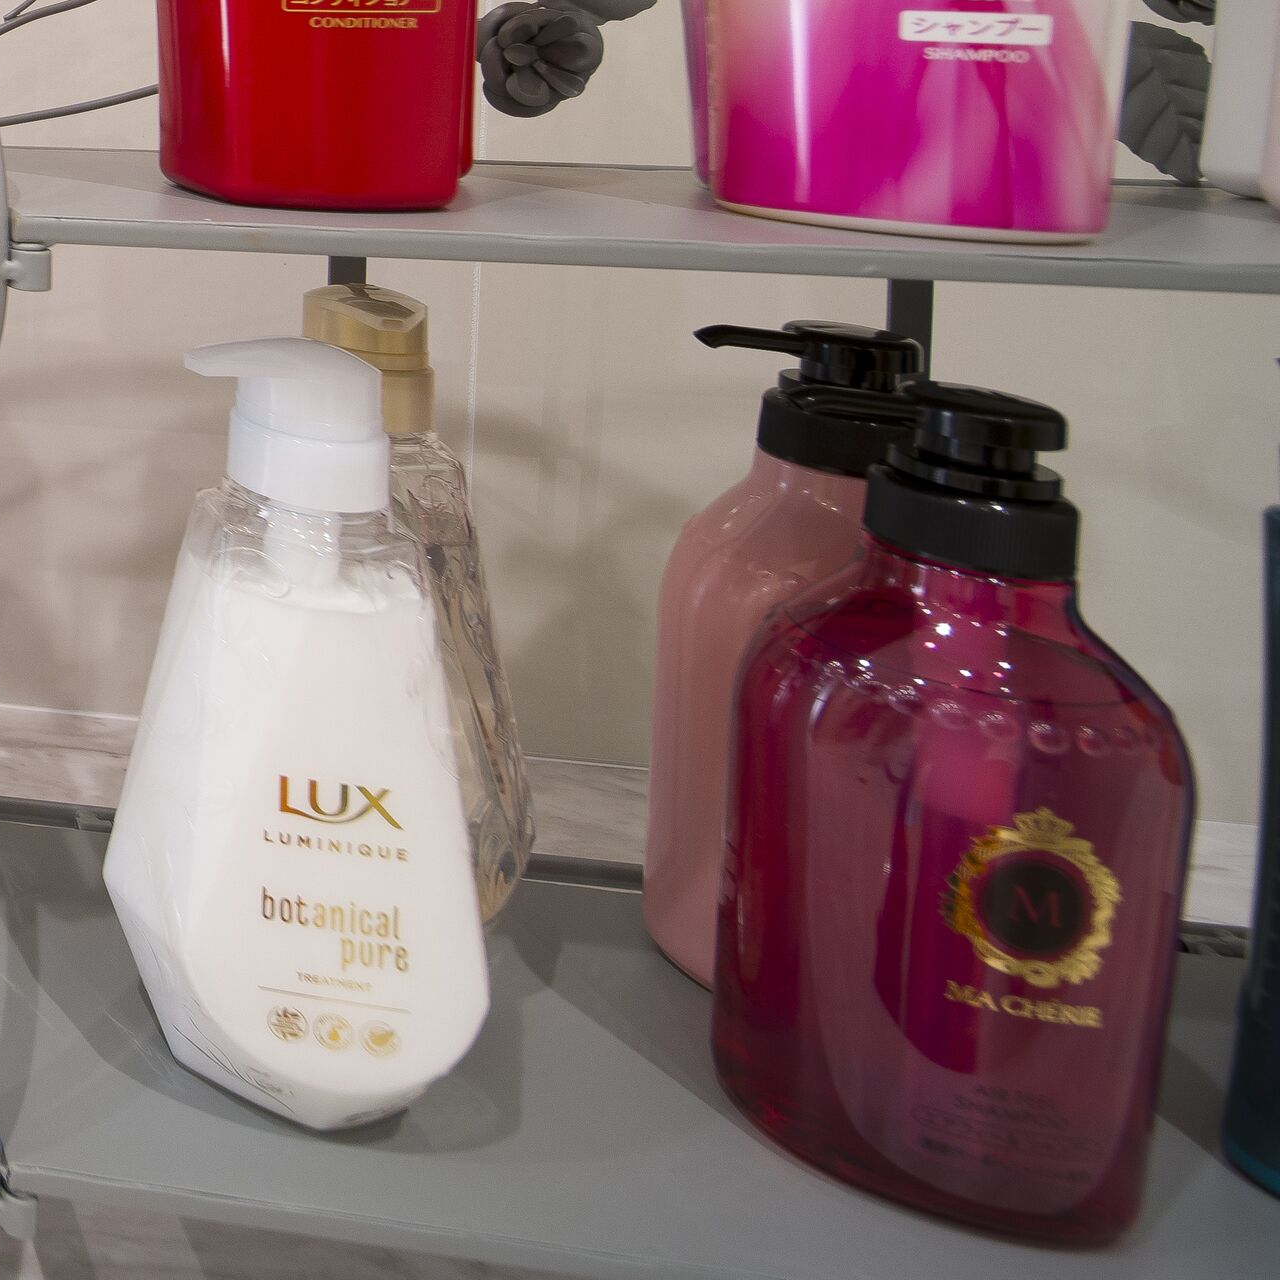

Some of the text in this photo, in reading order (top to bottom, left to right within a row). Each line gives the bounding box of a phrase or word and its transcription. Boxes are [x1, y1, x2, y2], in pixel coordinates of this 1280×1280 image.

[308, 16, 418, 30] CONDITIONER
[911, 17, 1042, 37] シャンプー
[923, 46, 1030, 64] SHAMPOO
[278, 774, 405, 832] LUX
[263, 829, 410, 862] LUMINIQUE
[261, 885, 401, 940] botanical
[1008, 884, 1062, 928] M
[340, 936, 410, 973] pure
[296, 970, 373, 993] TREATMENT
